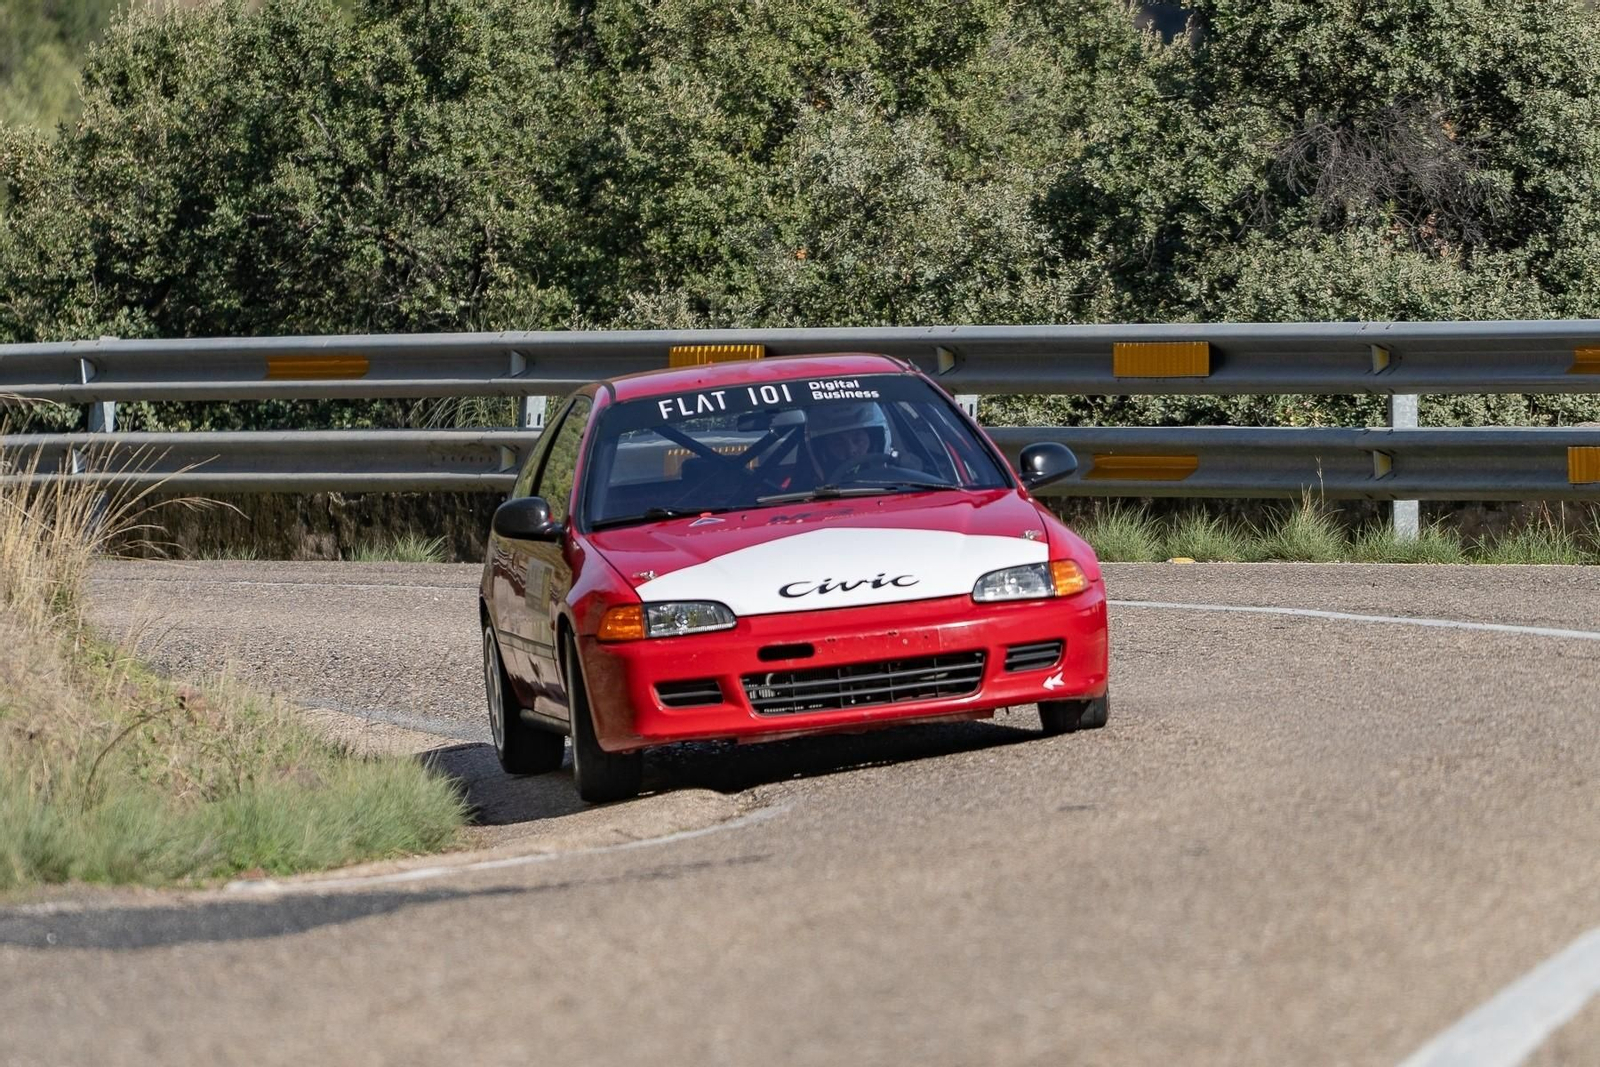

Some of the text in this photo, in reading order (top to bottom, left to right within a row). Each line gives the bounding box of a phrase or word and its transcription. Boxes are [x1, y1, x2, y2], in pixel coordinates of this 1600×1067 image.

[808, 379, 860, 391] Digital
[811, 390, 880, 400] Business
[658, 390, 726, 420] FLAT
